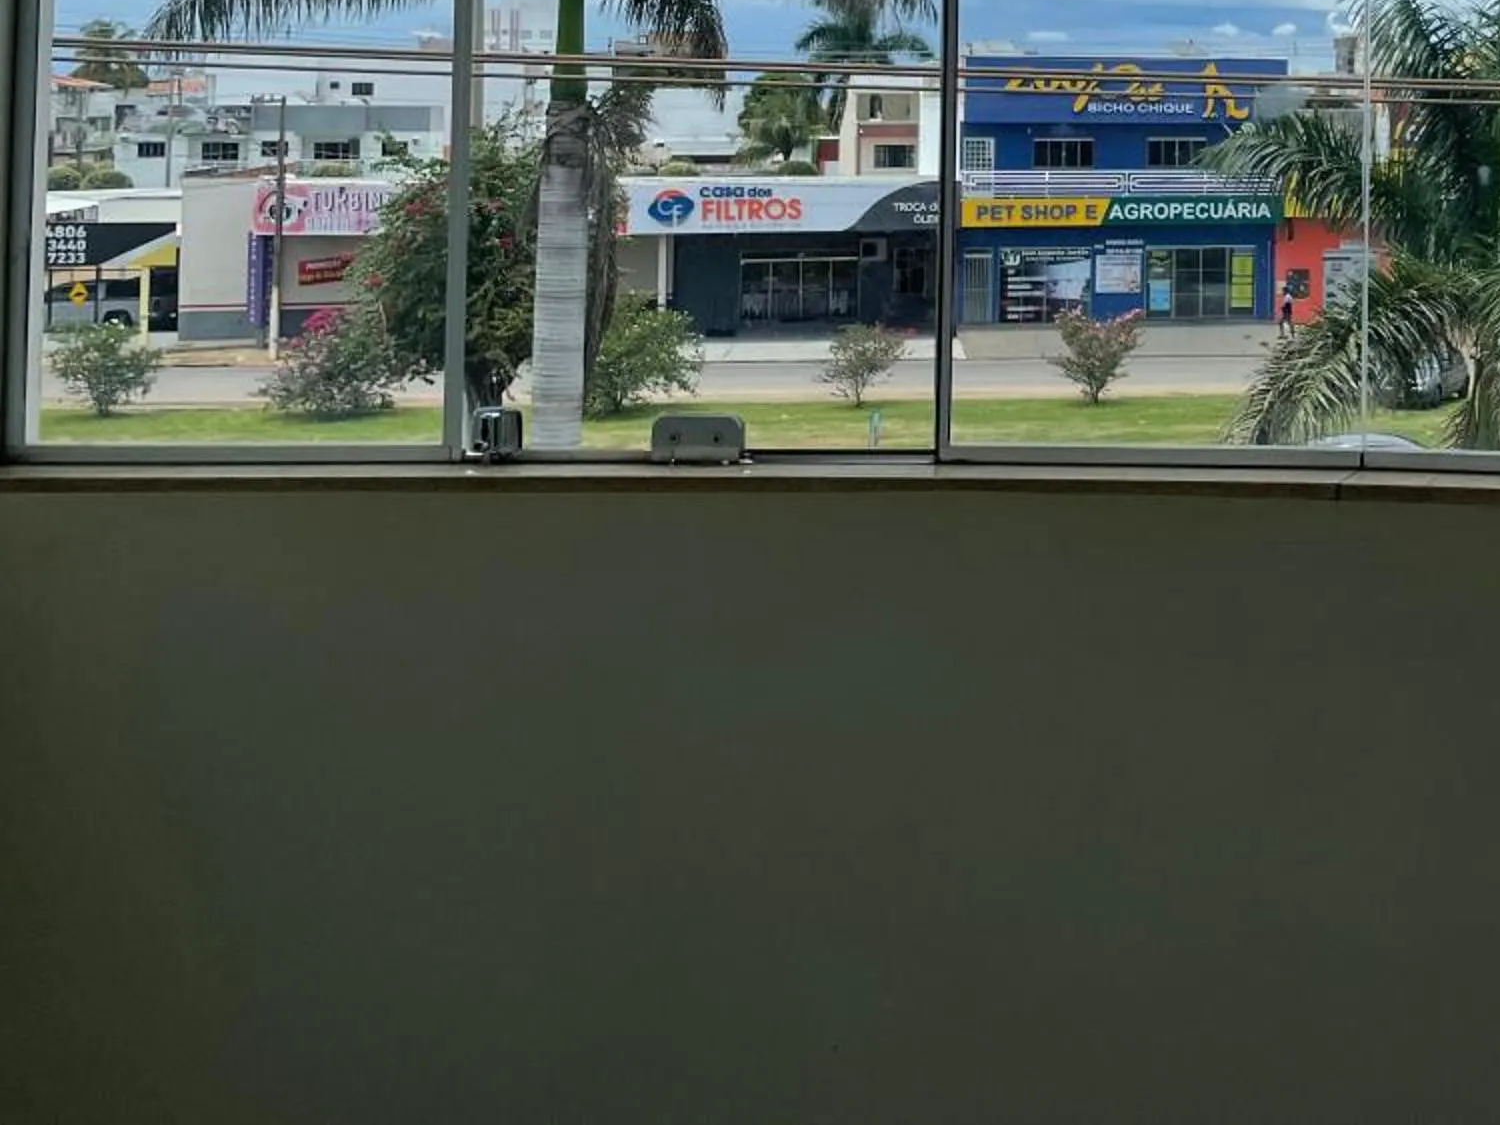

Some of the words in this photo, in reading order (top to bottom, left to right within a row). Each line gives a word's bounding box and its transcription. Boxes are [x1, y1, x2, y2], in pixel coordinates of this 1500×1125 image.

[1088, 103, 1134, 114] BICHO
[1137, 103, 1194, 114] CHIQUE
[701, 198, 802, 221] FILTROS
[894, 202, 927, 212] TROCA
[976, 204, 1014, 221] PET
[1021, 204, 1076, 221] SHOP
[1085, 204, 1098, 220] E
[1108, 199, 1271, 220] AGROPECUÁRIA
[47, 239, 87, 251] 3440
[47, 252, 86, 264] 7233
